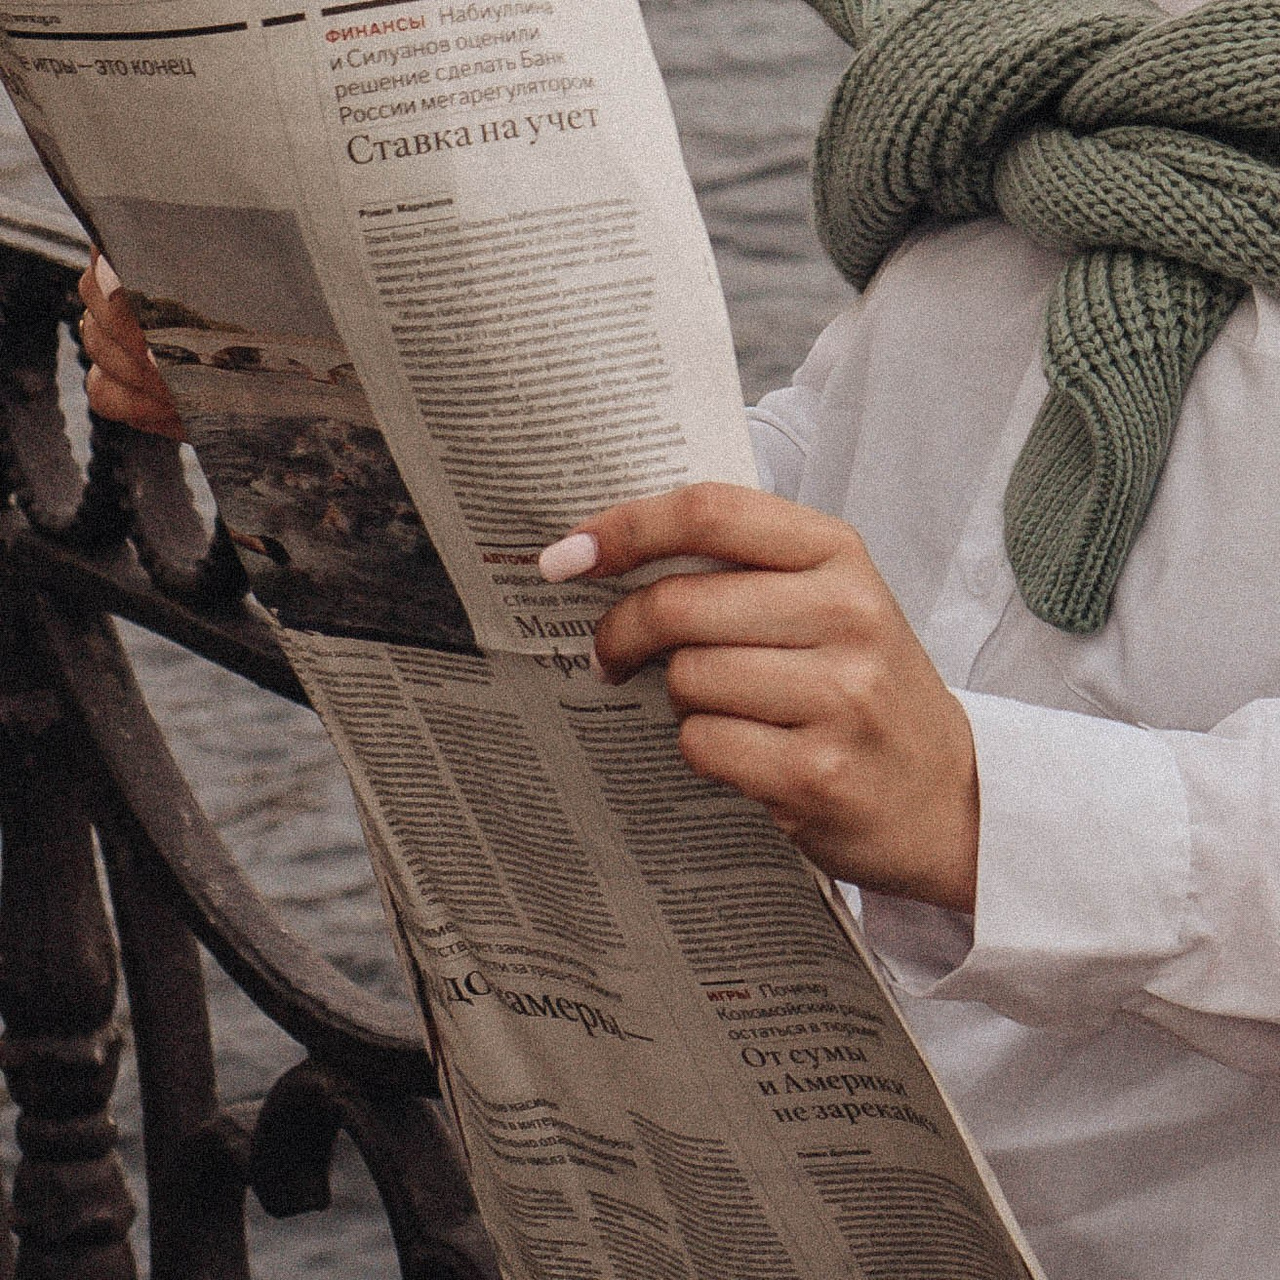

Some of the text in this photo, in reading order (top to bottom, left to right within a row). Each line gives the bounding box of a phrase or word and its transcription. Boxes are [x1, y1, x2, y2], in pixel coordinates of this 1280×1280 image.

[324, 0, 555, 44] ФИНАНСЫ Набиуллина
[131, 57, 197, 78] конец
[329, 24, 541, 72] и Силуанов оценили
[334, 49, 566, 103] решение сделать Банк
[338, 74, 595, 126] России мегарегулятором
[345, 105, 600, 167] Ставка на учет
[741, 1045, 868, 1070] От сумы
[757, 1072, 909, 1098] и Америки
[772, 1106, 807, 1123] не
